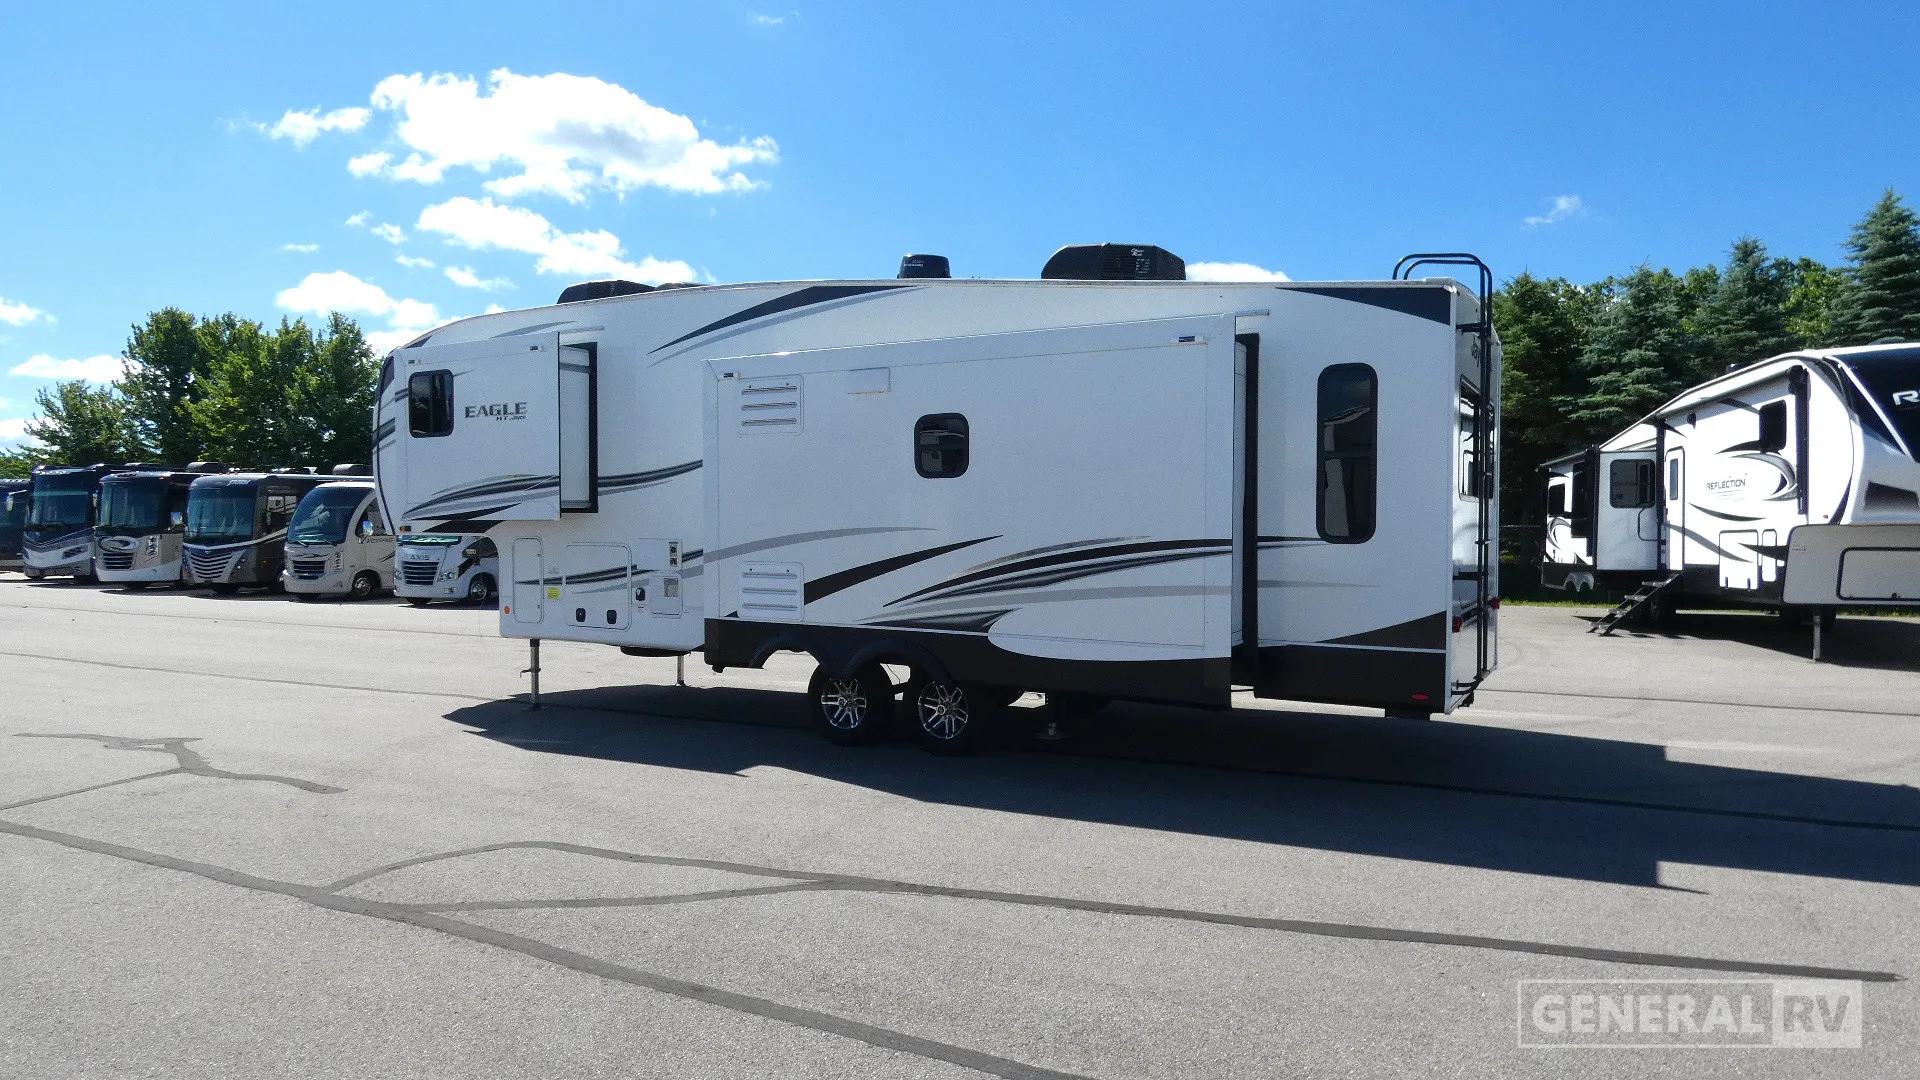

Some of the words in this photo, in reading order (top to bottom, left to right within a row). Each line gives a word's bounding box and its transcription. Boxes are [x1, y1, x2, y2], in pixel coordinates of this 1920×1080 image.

[1892, 390, 1920, 406] R
[464, 401, 528, 419] EAGLE
[1705, 478, 1746, 490] REFLECTION
